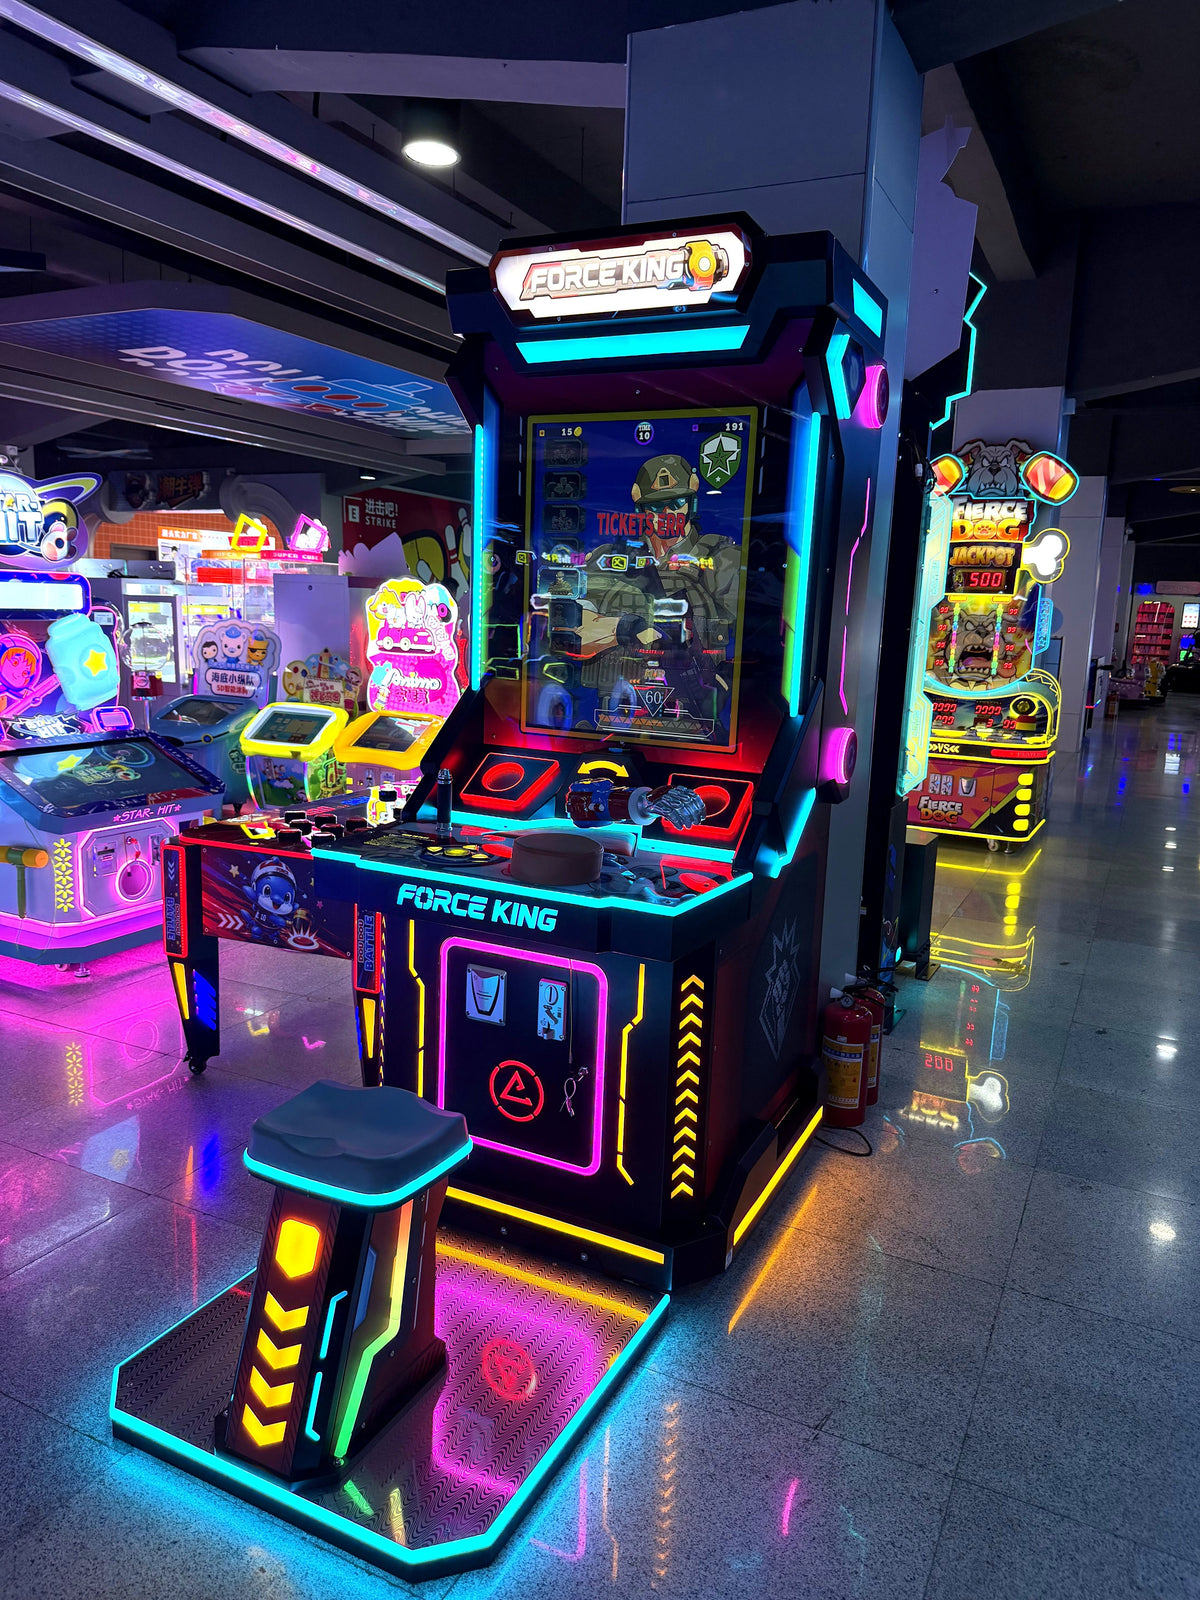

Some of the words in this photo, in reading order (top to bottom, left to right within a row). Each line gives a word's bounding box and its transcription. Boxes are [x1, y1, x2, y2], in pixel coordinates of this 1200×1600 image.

[530, 261, 616, 293] FORCE
[623, 255, 685, 284] KING
[561, 427, 573, 437] 15
[639, 432, 650, 441] 10
[725, 423, 744, 432] 191
[955, 498, 1028, 522] FIERCE
[365, 516, 396, 529] STRIKE
[597, 513, 653, 536] TICKETS
[656, 512, 686, 536] ERR
[952, 519, 1021, 541] DOG
[950, 546, 1016, 567] JACKPOT
[969, 571, 1003, 588] 500
[645, 690, 662, 704] 60
[157, 804, 175, 816] HIT
[918, 796, 963, 814] FIERCE
[920, 808, 959, 824] DOG
[397, 883, 488, 919] FORCE
[491, 901, 559, 933] KING
[166, 897, 176, 941] BATTLE
[364, 914, 375, 972] BATTLE
